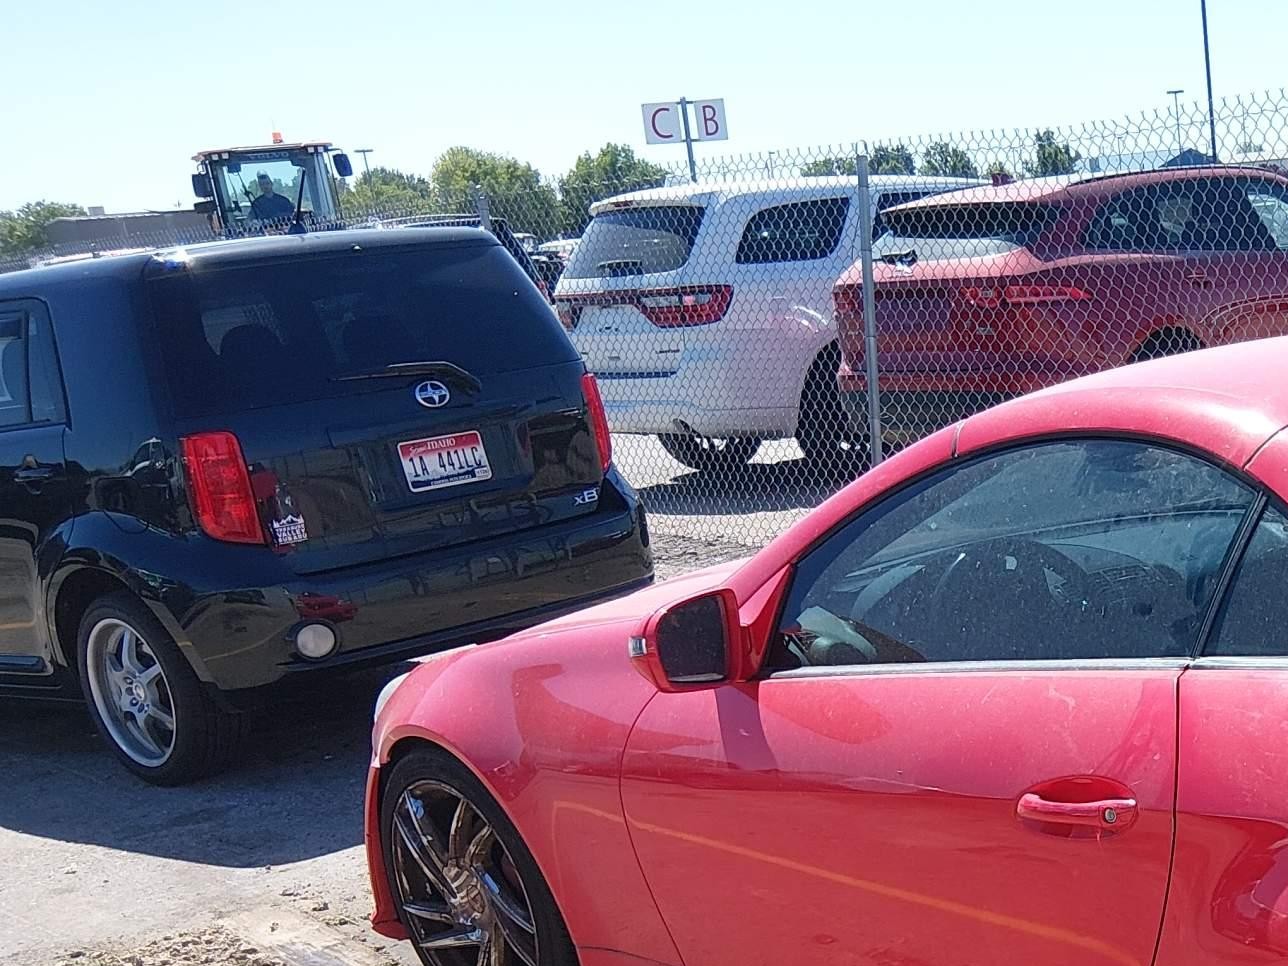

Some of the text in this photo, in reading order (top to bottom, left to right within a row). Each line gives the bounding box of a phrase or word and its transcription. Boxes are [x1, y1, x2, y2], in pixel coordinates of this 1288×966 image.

[651, 107, 674, 139] C
[702, 104, 719, 136] B
[427, 438, 456, 450] IDAHO
[408, 455, 429, 478] 1A
[438, 446, 482, 473] 441LC
[574, 490, 599, 506] xB
[275, 526, 306, 538] VALLEY
